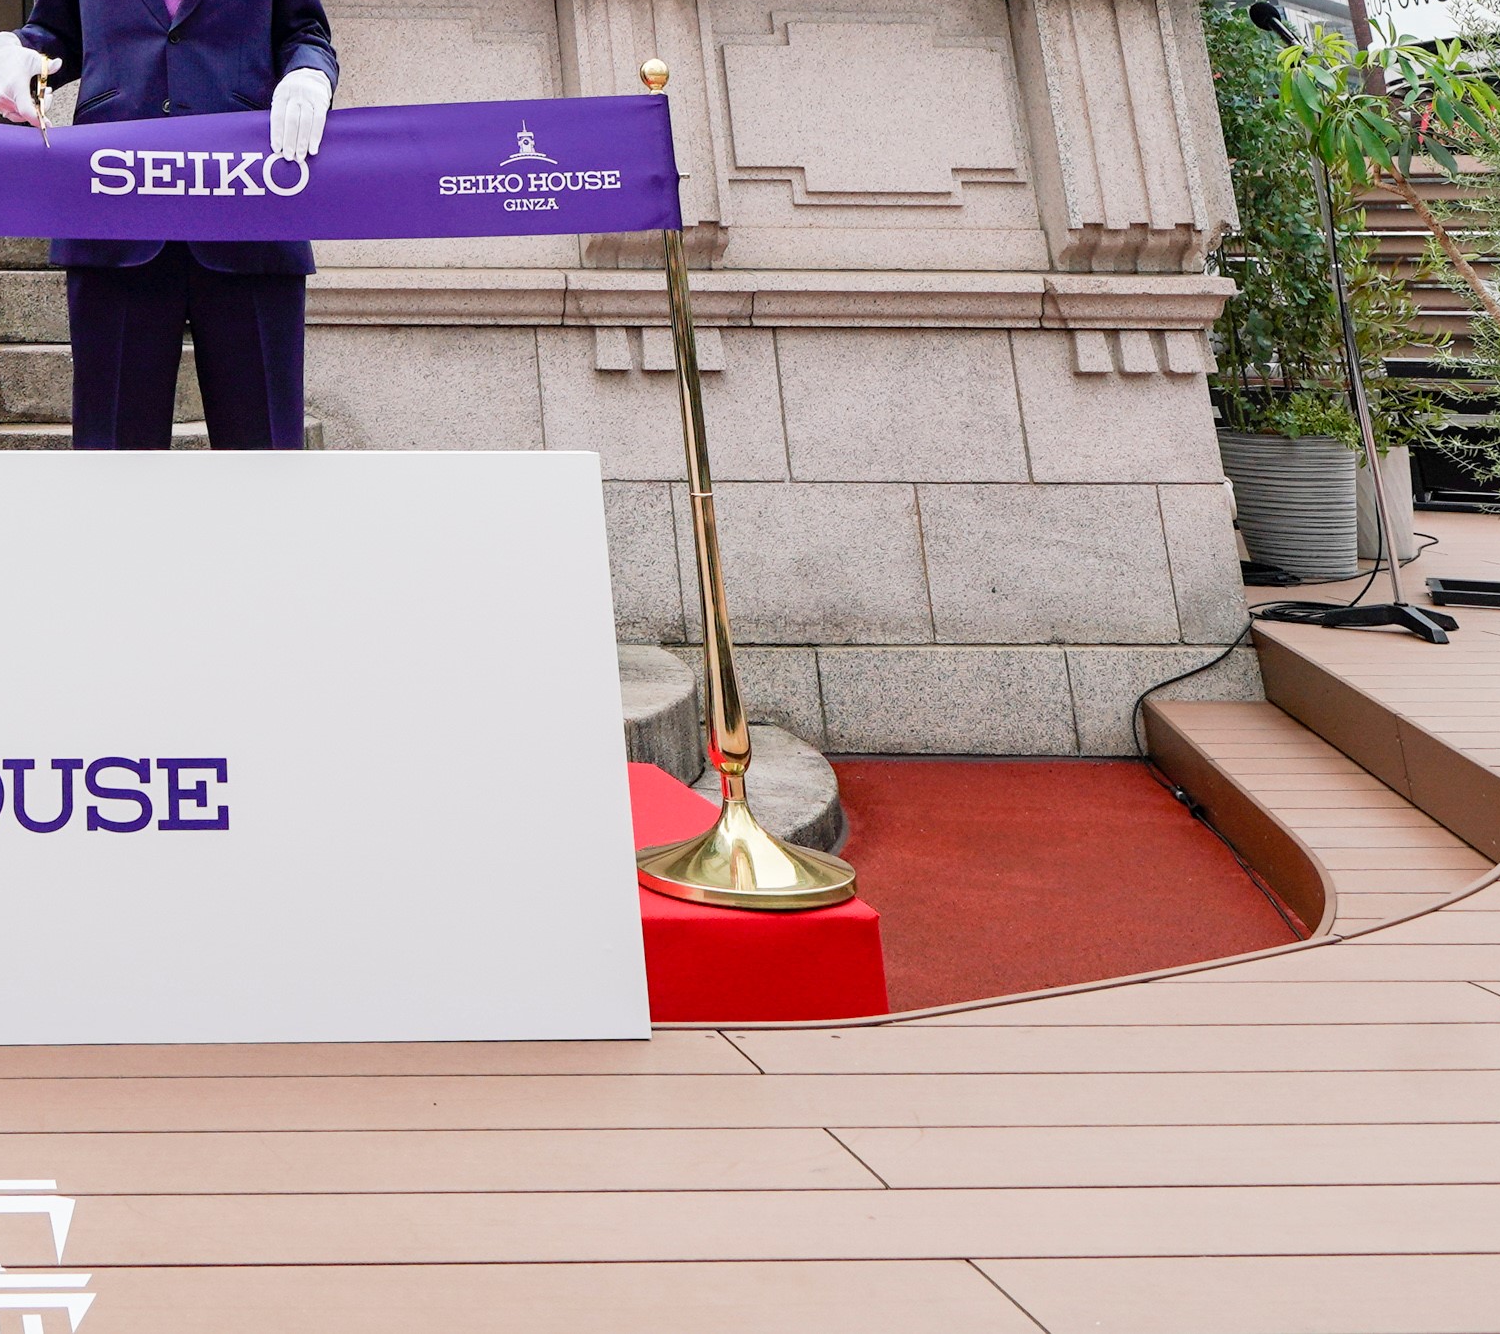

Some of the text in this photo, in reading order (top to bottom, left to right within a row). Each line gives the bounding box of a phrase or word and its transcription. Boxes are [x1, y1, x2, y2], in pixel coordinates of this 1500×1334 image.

[90, 148, 310, 197] SEIKO
[438, 170, 621, 195] SEIKO HOUSE
[503, 197, 560, 212] GINZA
